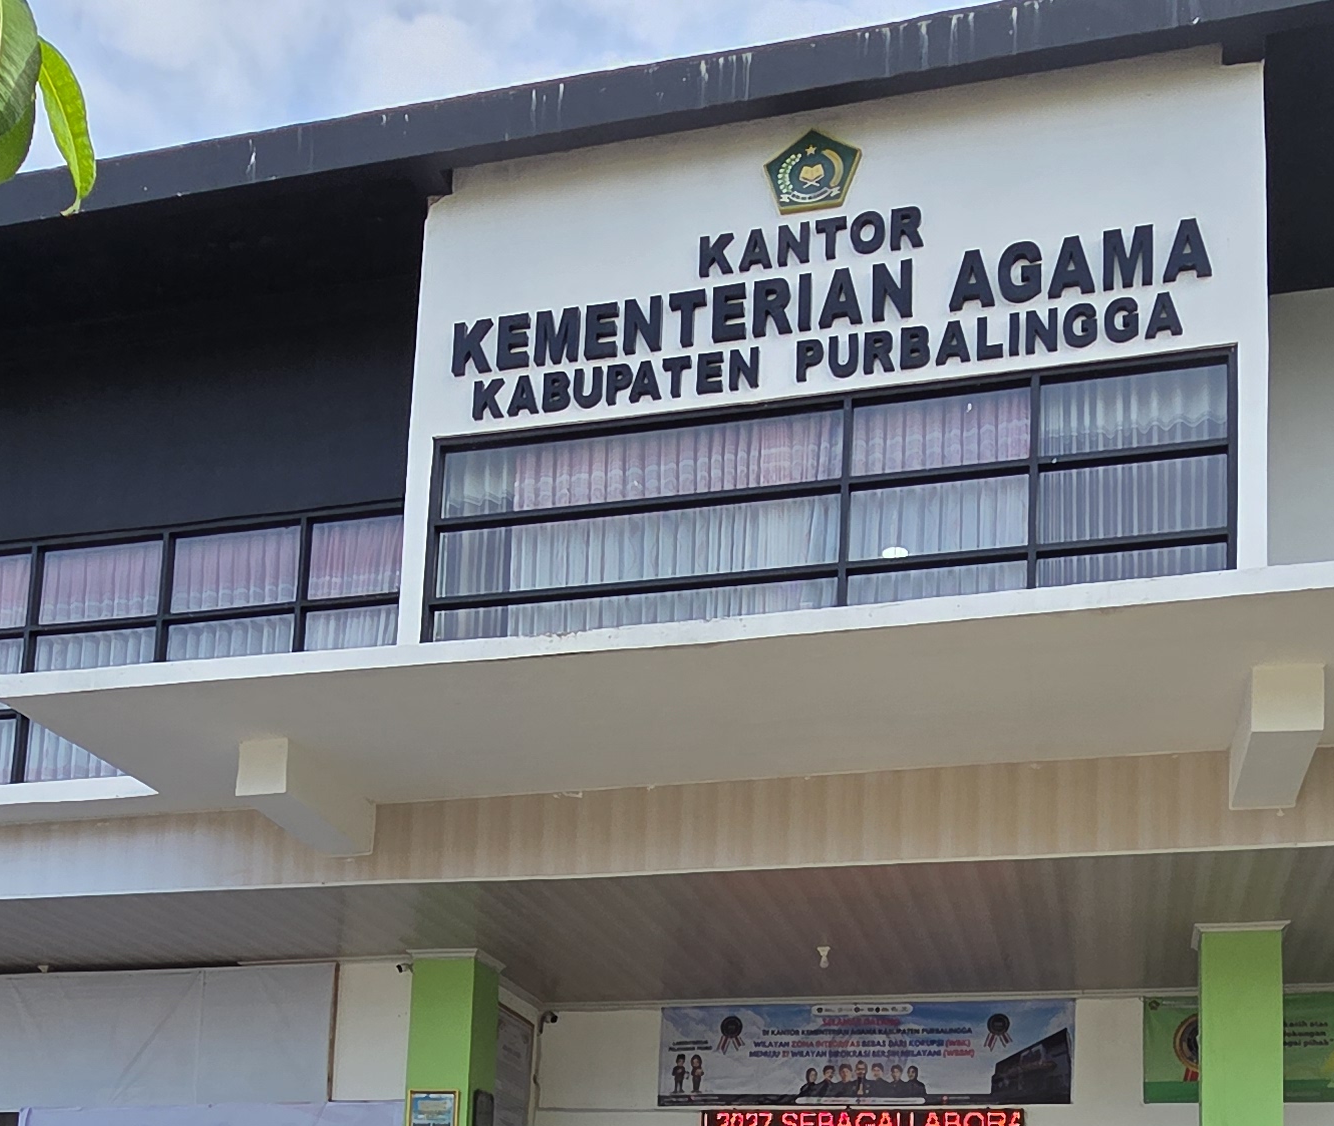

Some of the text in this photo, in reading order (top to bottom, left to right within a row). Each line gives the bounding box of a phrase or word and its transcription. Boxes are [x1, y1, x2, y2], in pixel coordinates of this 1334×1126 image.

[451, 217, 1213, 377] KEMENTERIAN AGAMA
[698, 206, 924, 278] KANTOR
[471, 291, 1183, 421] KABUPATEN PURBALINGGA
